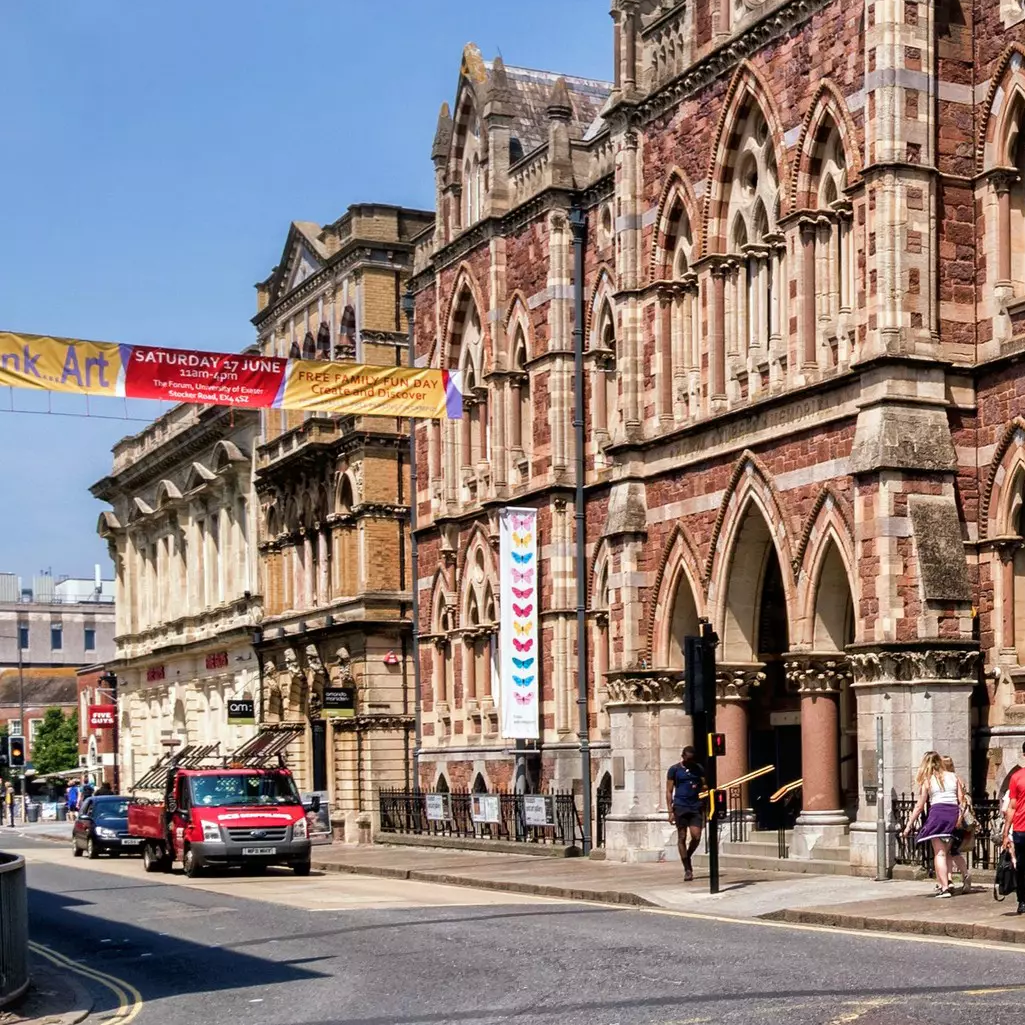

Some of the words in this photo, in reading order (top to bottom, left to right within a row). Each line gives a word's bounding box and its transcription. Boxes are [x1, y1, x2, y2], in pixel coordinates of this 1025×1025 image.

[60, 344, 110, 388] Art
[135, 350, 220, 369] SATURDAY
[223, 361, 239, 373] 17
[241, 359, 281, 374] JUNE
[179, 369, 238, 382] 11am-4pm
[298, 371, 330, 383] FREE
[335, 373, 379, 386] FAMILY
[383, 376, 409, 388] FUN
[413, 378, 438, 389] DAY
[153, 379, 167, 387] The
[168, 380, 194, 391] Forum,
[195, 383, 231, 393] University
[232, 385, 240, 393] of
[311, 383, 350, 397] Create
[353, 386, 375, 397] and
[378, 388, 427, 400] Discover
[168, 389, 197, 399] Stocker
[197, 392, 218, 401] Road,
